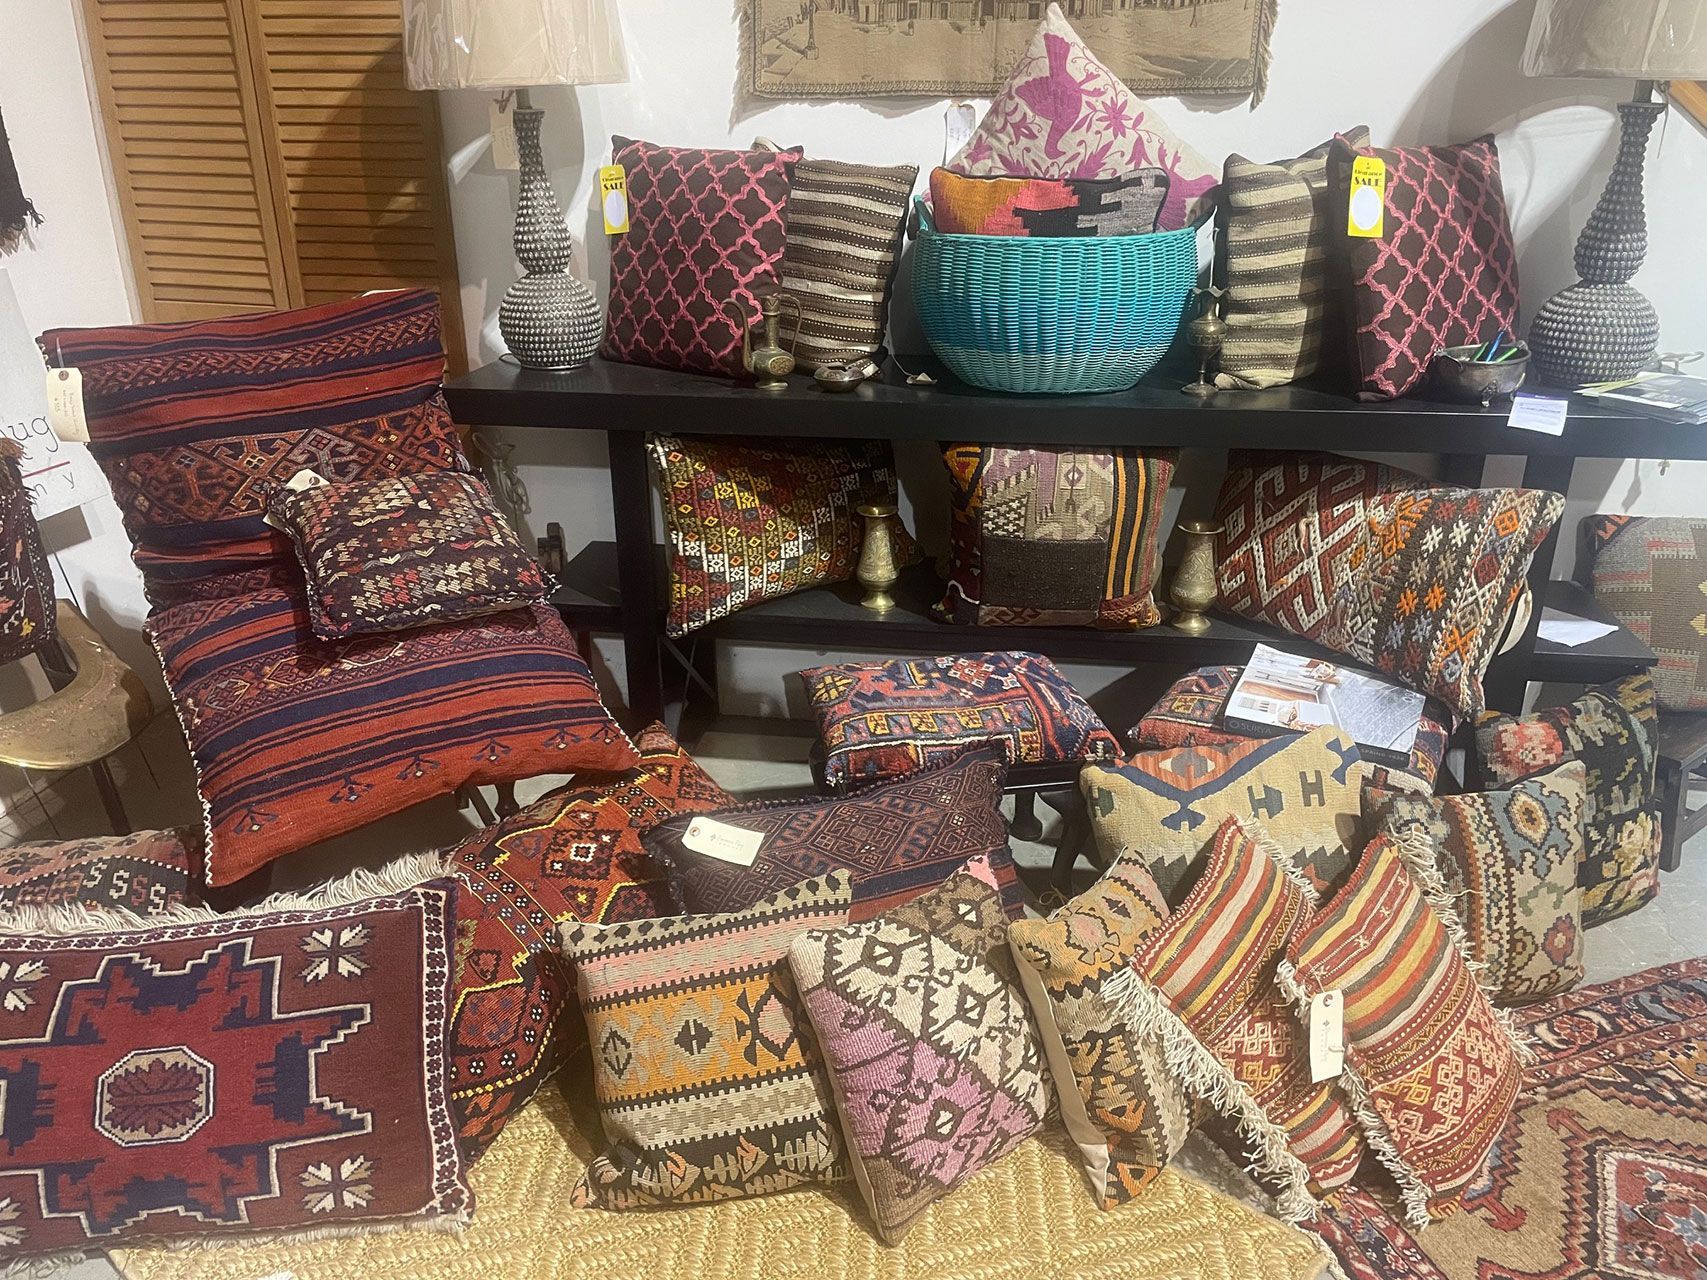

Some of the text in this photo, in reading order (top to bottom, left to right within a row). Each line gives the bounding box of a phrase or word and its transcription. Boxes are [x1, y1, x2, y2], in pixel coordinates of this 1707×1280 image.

[602, 182, 624, 191] SALE
[1353, 176, 1382, 187] SALE
[0, 415, 58, 452] ug
